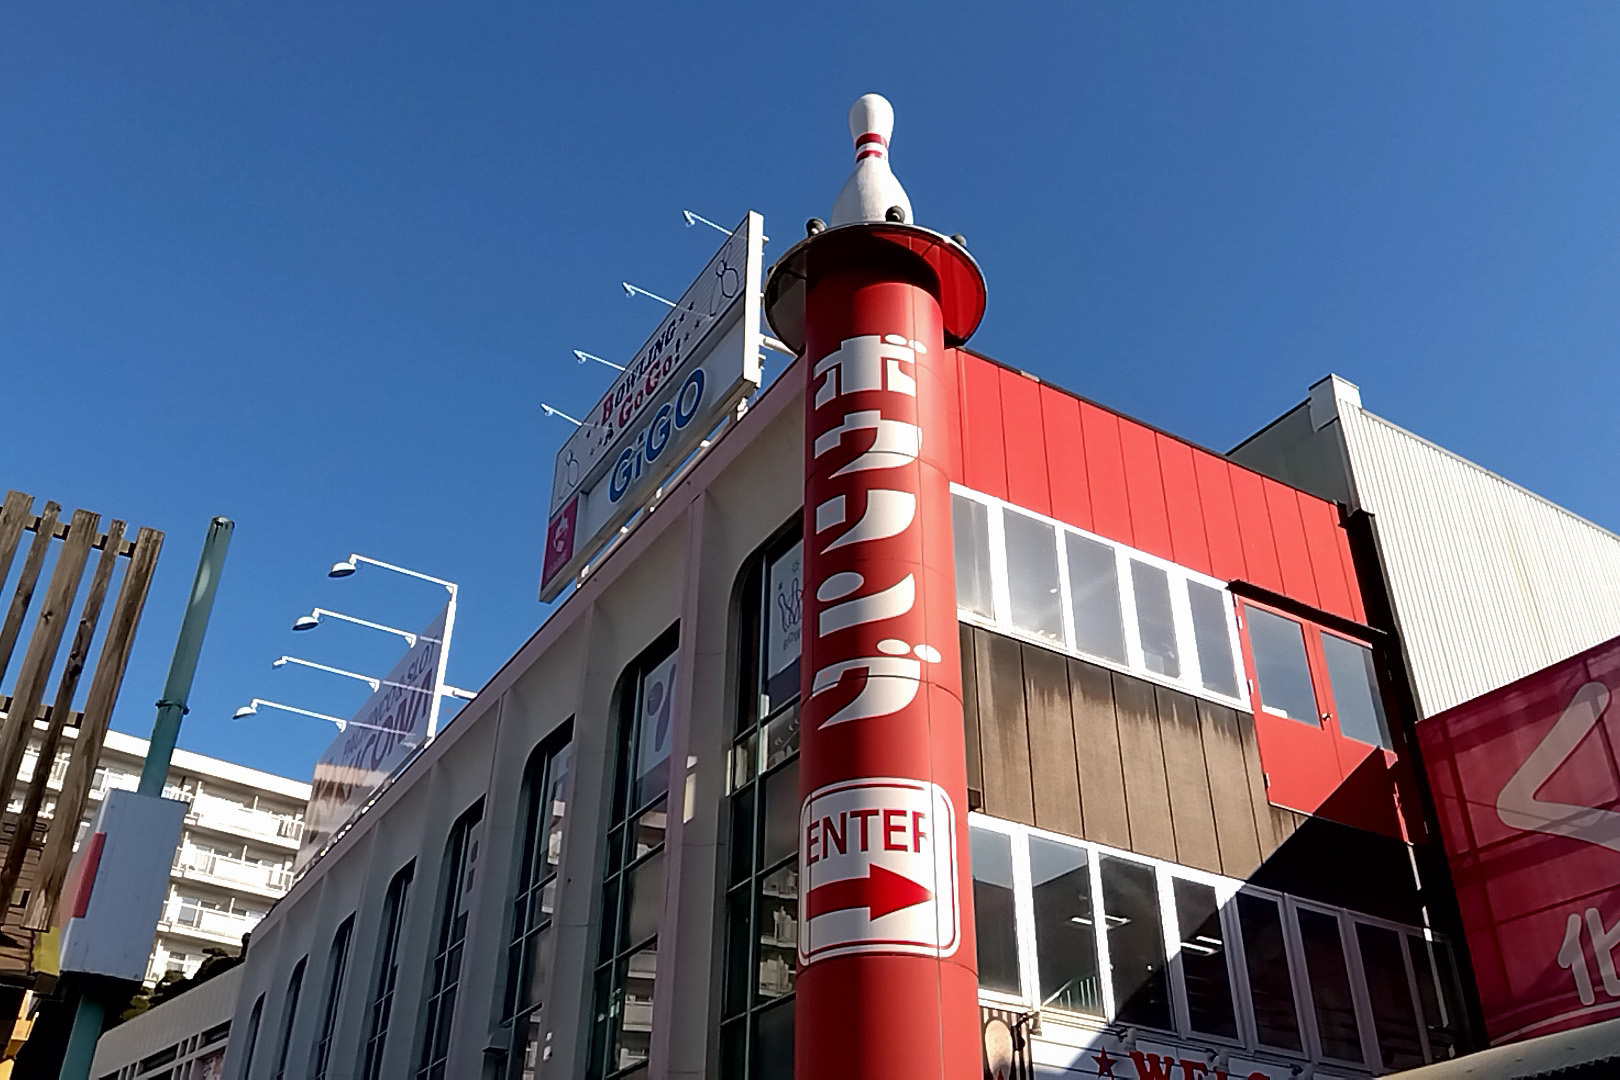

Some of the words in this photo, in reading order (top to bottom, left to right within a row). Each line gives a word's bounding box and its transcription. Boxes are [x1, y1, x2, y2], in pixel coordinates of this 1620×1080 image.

[601, 319, 676, 426] BOWLING
[609, 367, 707, 504] GiGO
[811, 333, 942, 731] ボウリング
